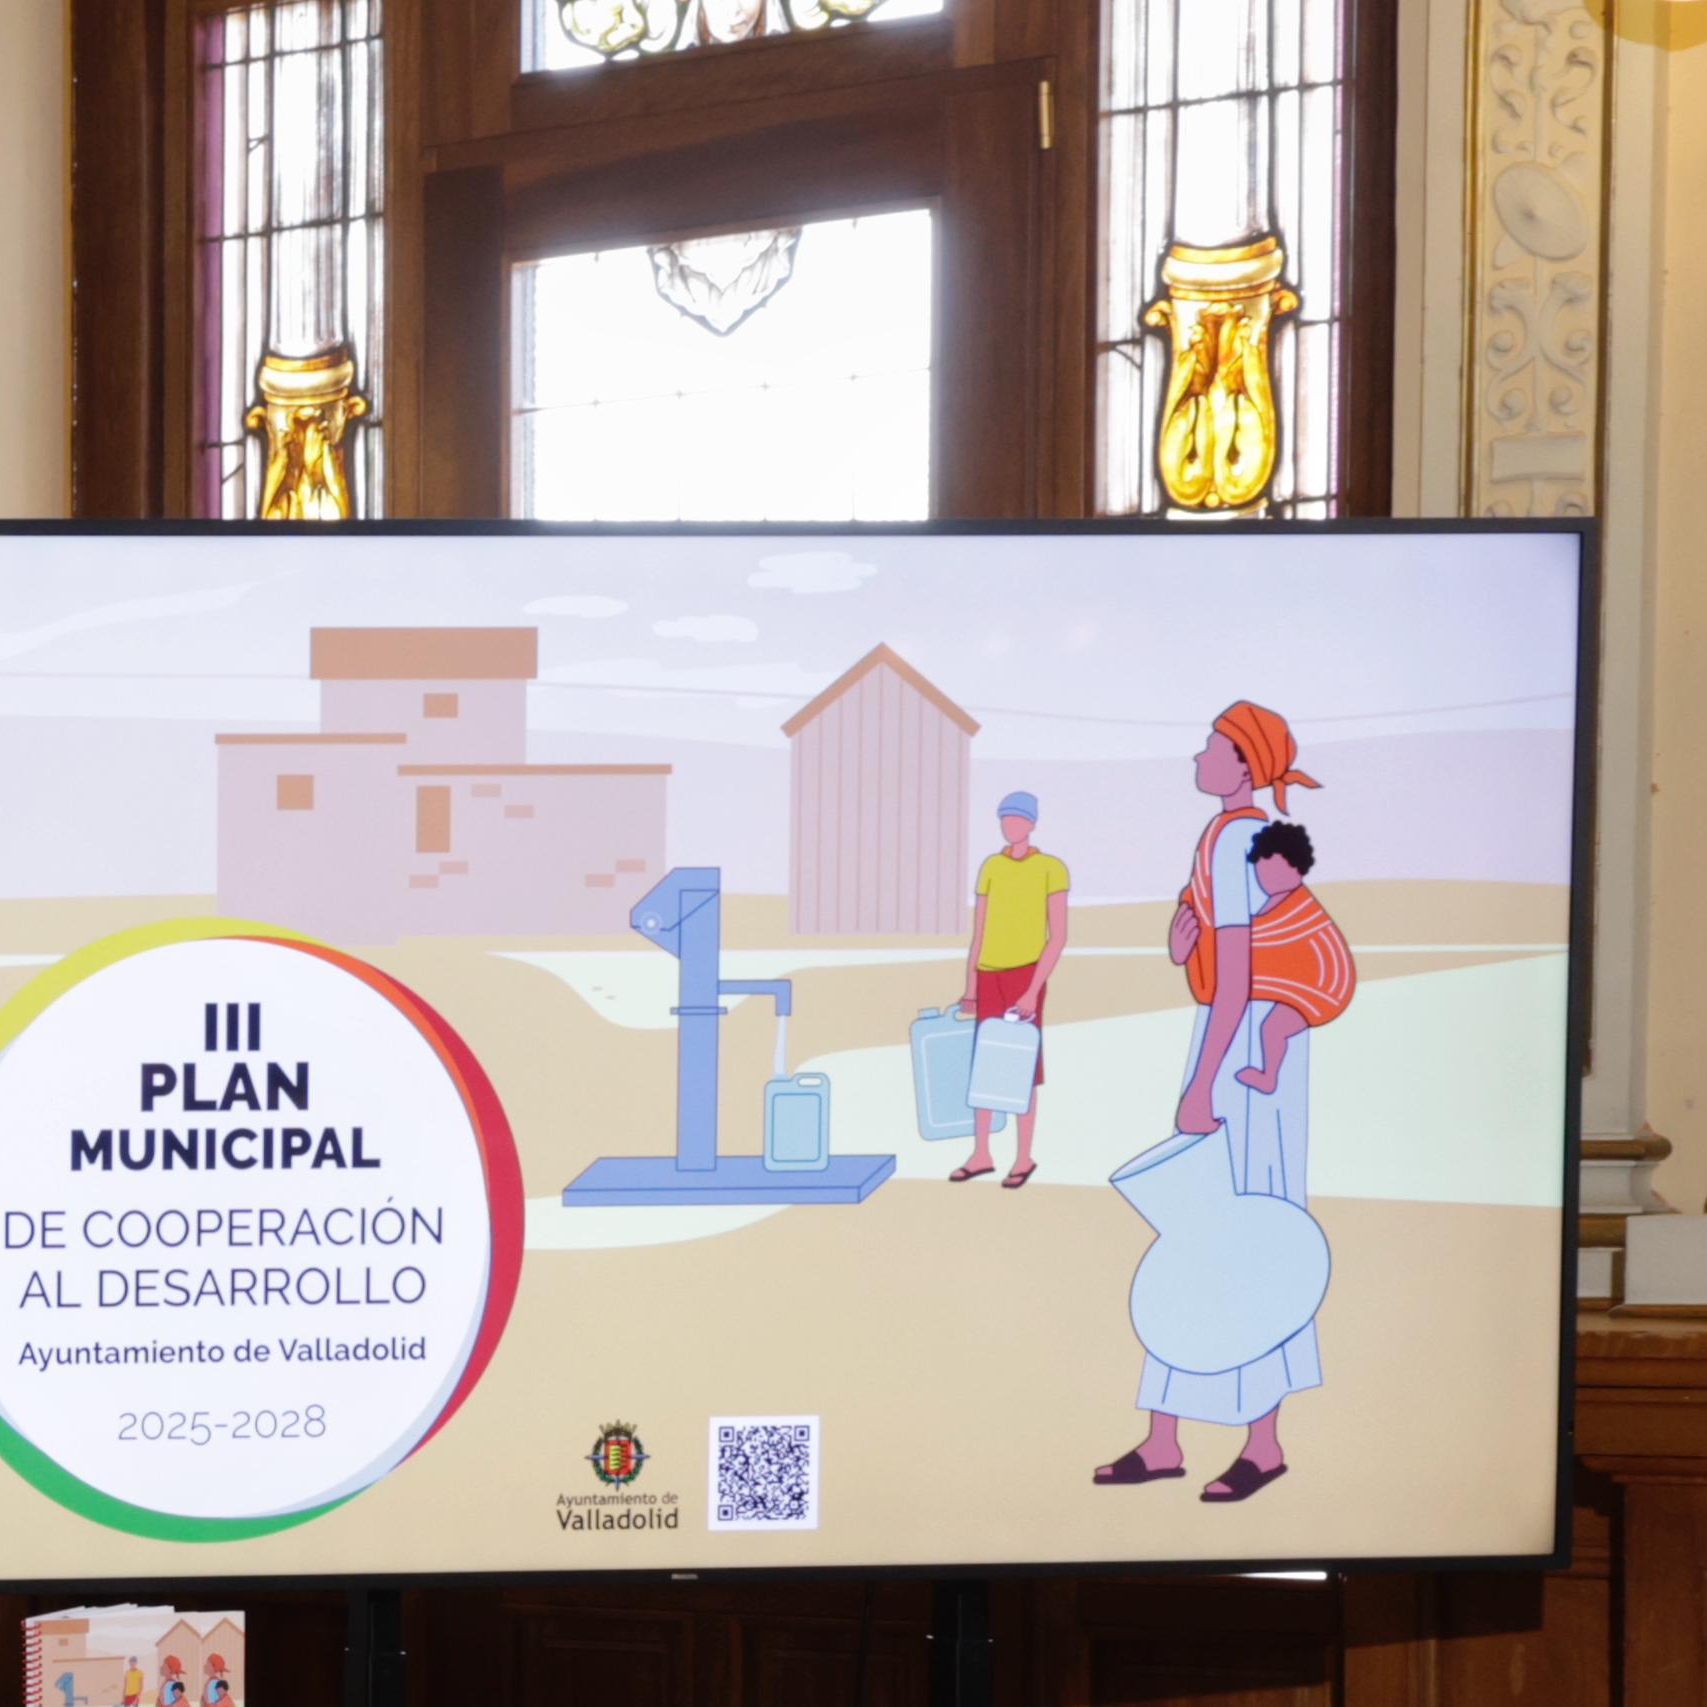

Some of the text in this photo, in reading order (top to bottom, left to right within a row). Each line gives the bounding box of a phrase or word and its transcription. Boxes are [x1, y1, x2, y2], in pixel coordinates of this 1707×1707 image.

[204, 1003, 261, 1051] III
[141, 1062, 309, 1111] PLAN
[71, 1127, 381, 1170] MUNICIPAL
[5, 1196, 443, 1249] DE COOPERACIÓN
[20, 1266, 426, 1308] AL DESARROLLO
[19, 1337, 426, 1371] Ayuntamiento de Valladolid
[118, 1404, 326, 1446] 2025-2028
[556, 1492, 678, 1508] Ayuntamiento de
[557, 1508, 679, 1530] Valladolid
